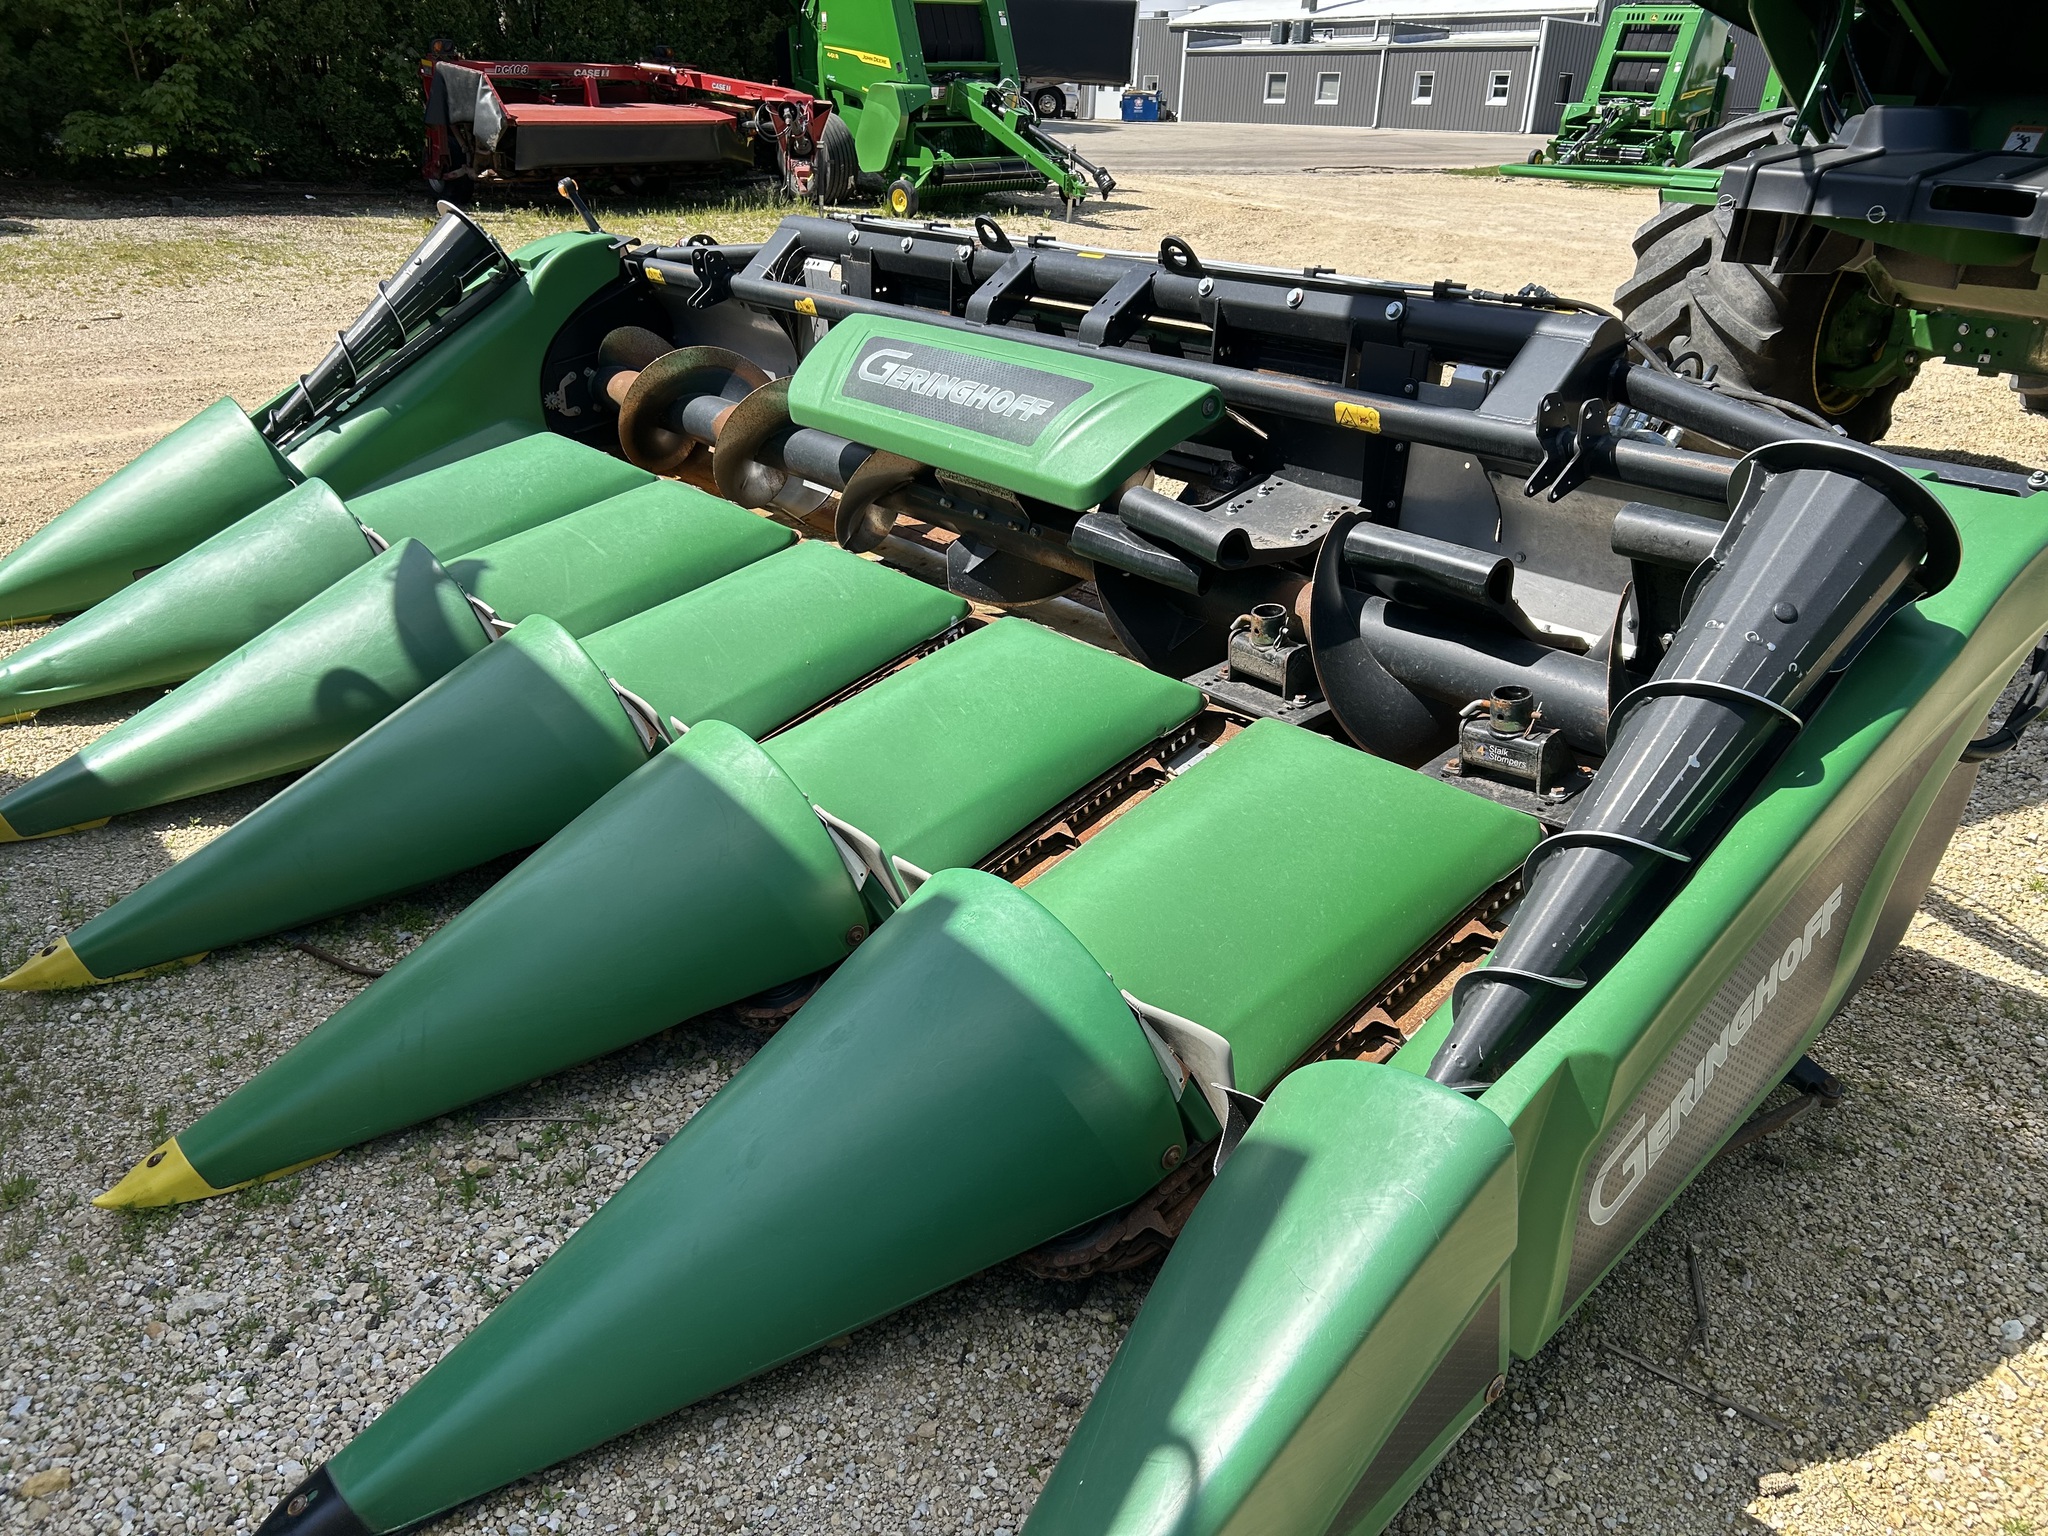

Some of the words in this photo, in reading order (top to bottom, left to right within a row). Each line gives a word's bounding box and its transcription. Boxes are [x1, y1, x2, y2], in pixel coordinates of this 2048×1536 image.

[873, 56, 887, 64] DEERE
[495, 65, 529, 75] DC103
[573, 69, 600, 77] CASE
[711, 82, 726, 91] CASE
[858, 348, 1054, 422] GERINGHOFF
[1476, 745, 1486, 756] 4
[1489, 745, 1509, 757] Stalk
[1489, 753, 1527, 770] Stompers
[1588, 882, 1843, 1226] GERINGHOFF
